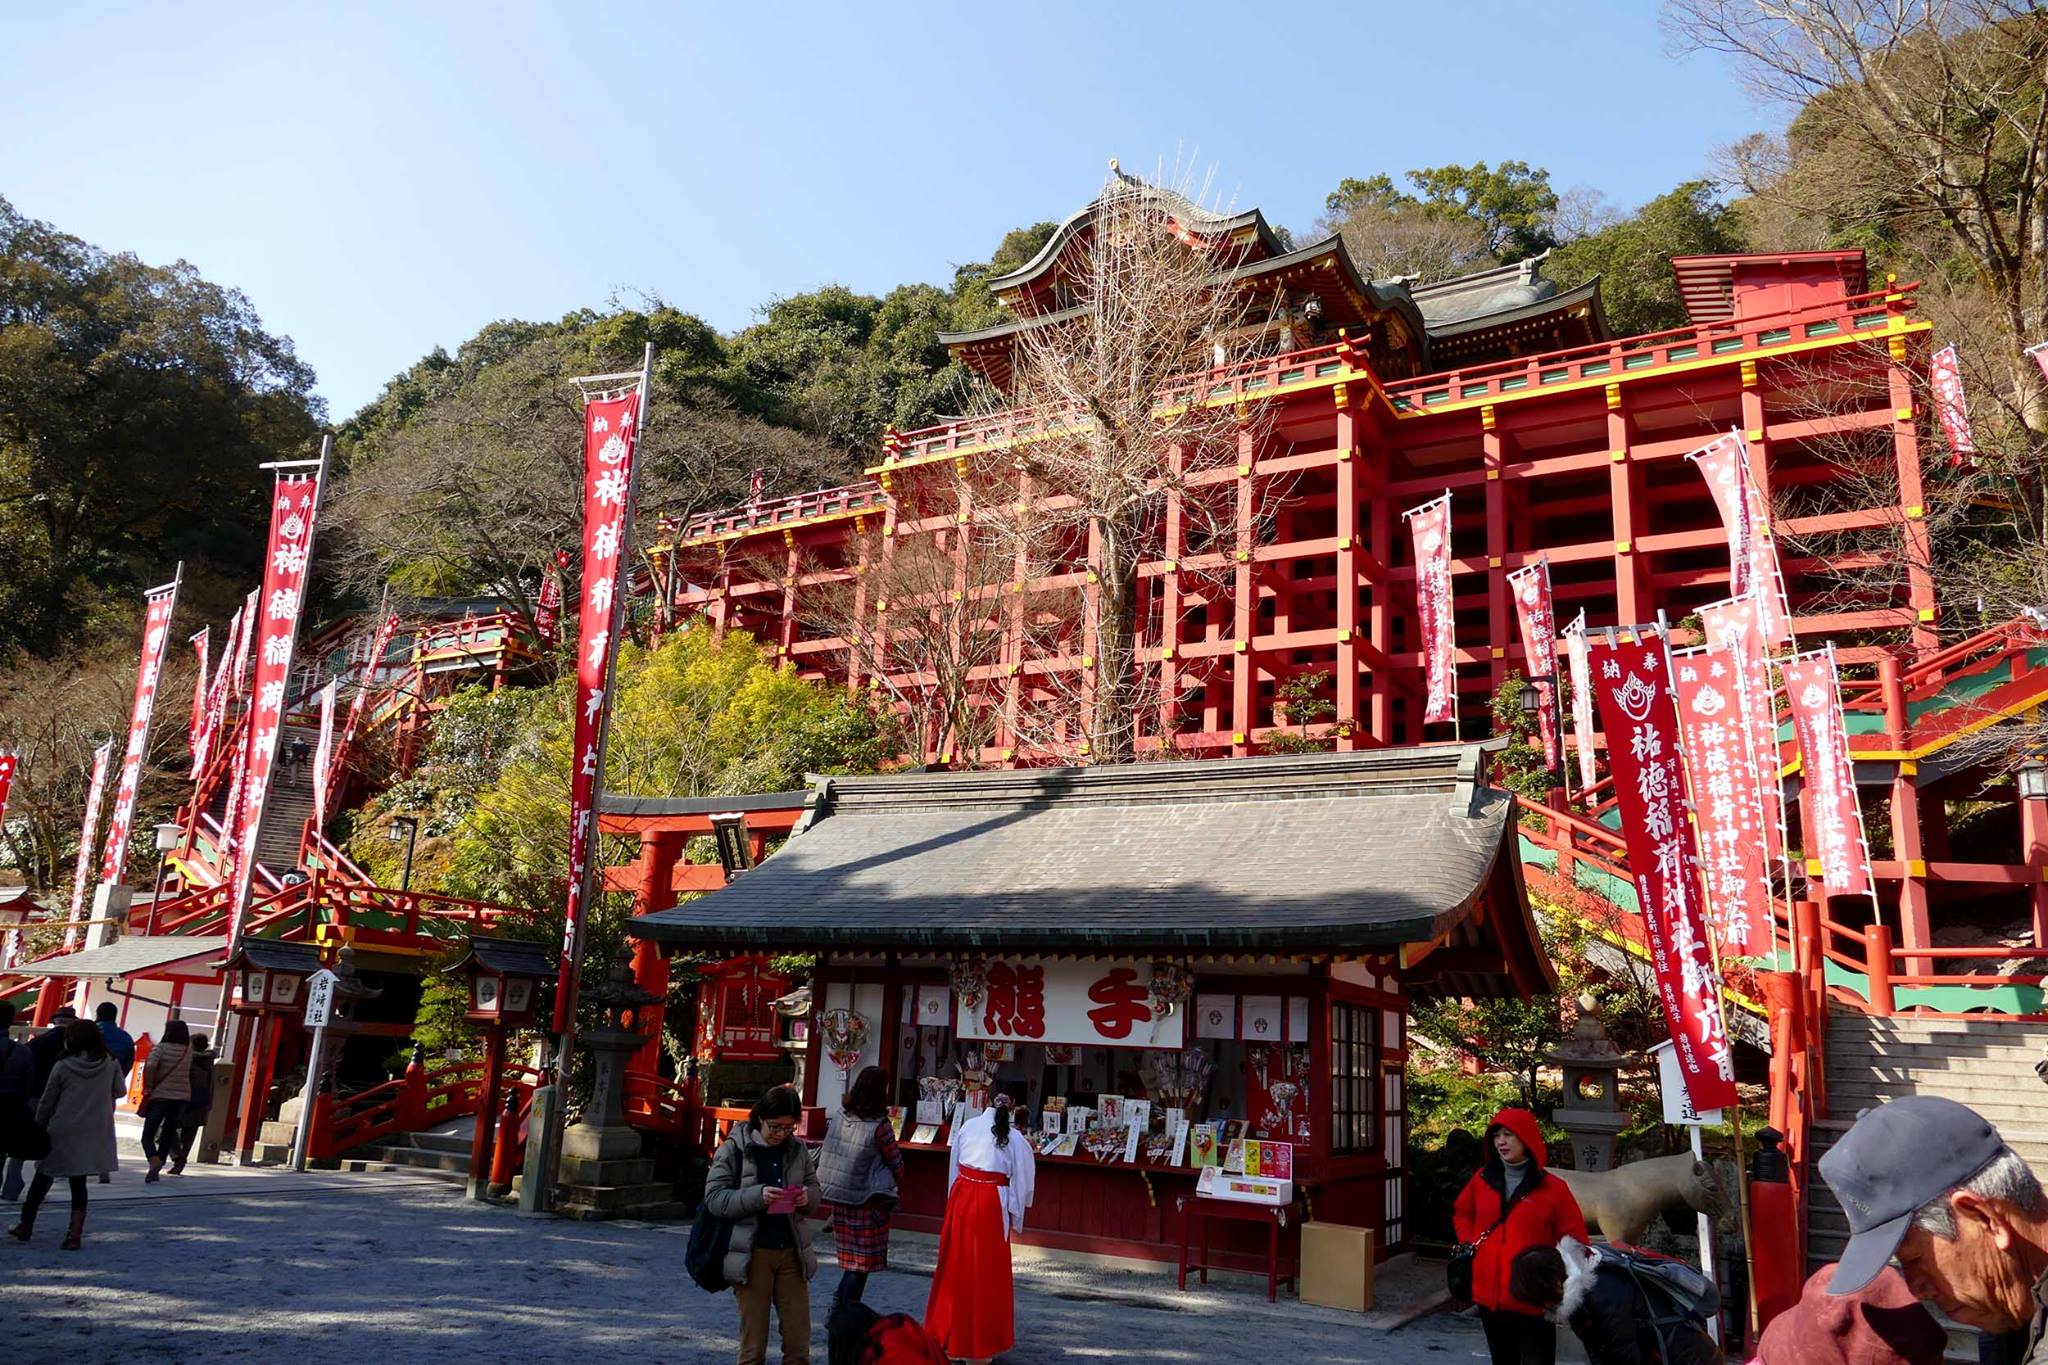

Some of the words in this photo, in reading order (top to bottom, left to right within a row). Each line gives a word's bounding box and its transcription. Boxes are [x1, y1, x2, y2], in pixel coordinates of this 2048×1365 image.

[1602, 652, 1658, 679] 奉納
[1680, 661, 1727, 682] 奉納
[983, 962, 1153, 1041] 熊手
